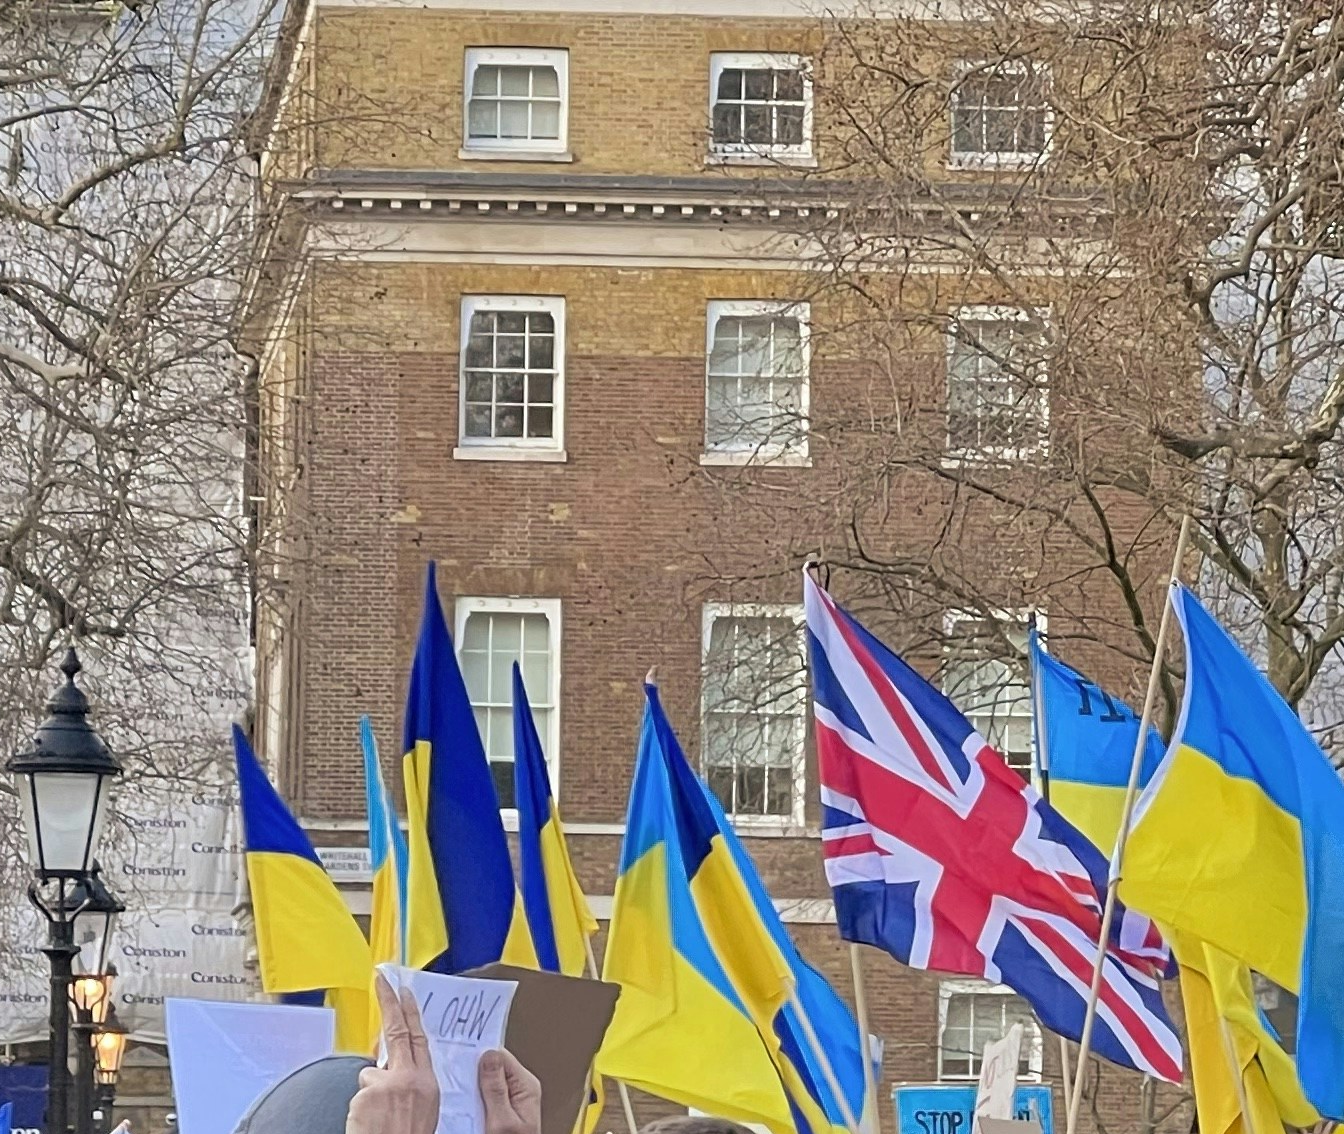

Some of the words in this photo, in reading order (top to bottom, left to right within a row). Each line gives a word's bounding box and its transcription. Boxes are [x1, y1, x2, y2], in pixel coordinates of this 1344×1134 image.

[123, 864, 186, 877] Coniston
[324, 862, 360, 870] ARDENS
[122, 945, 186, 957] Coniston
